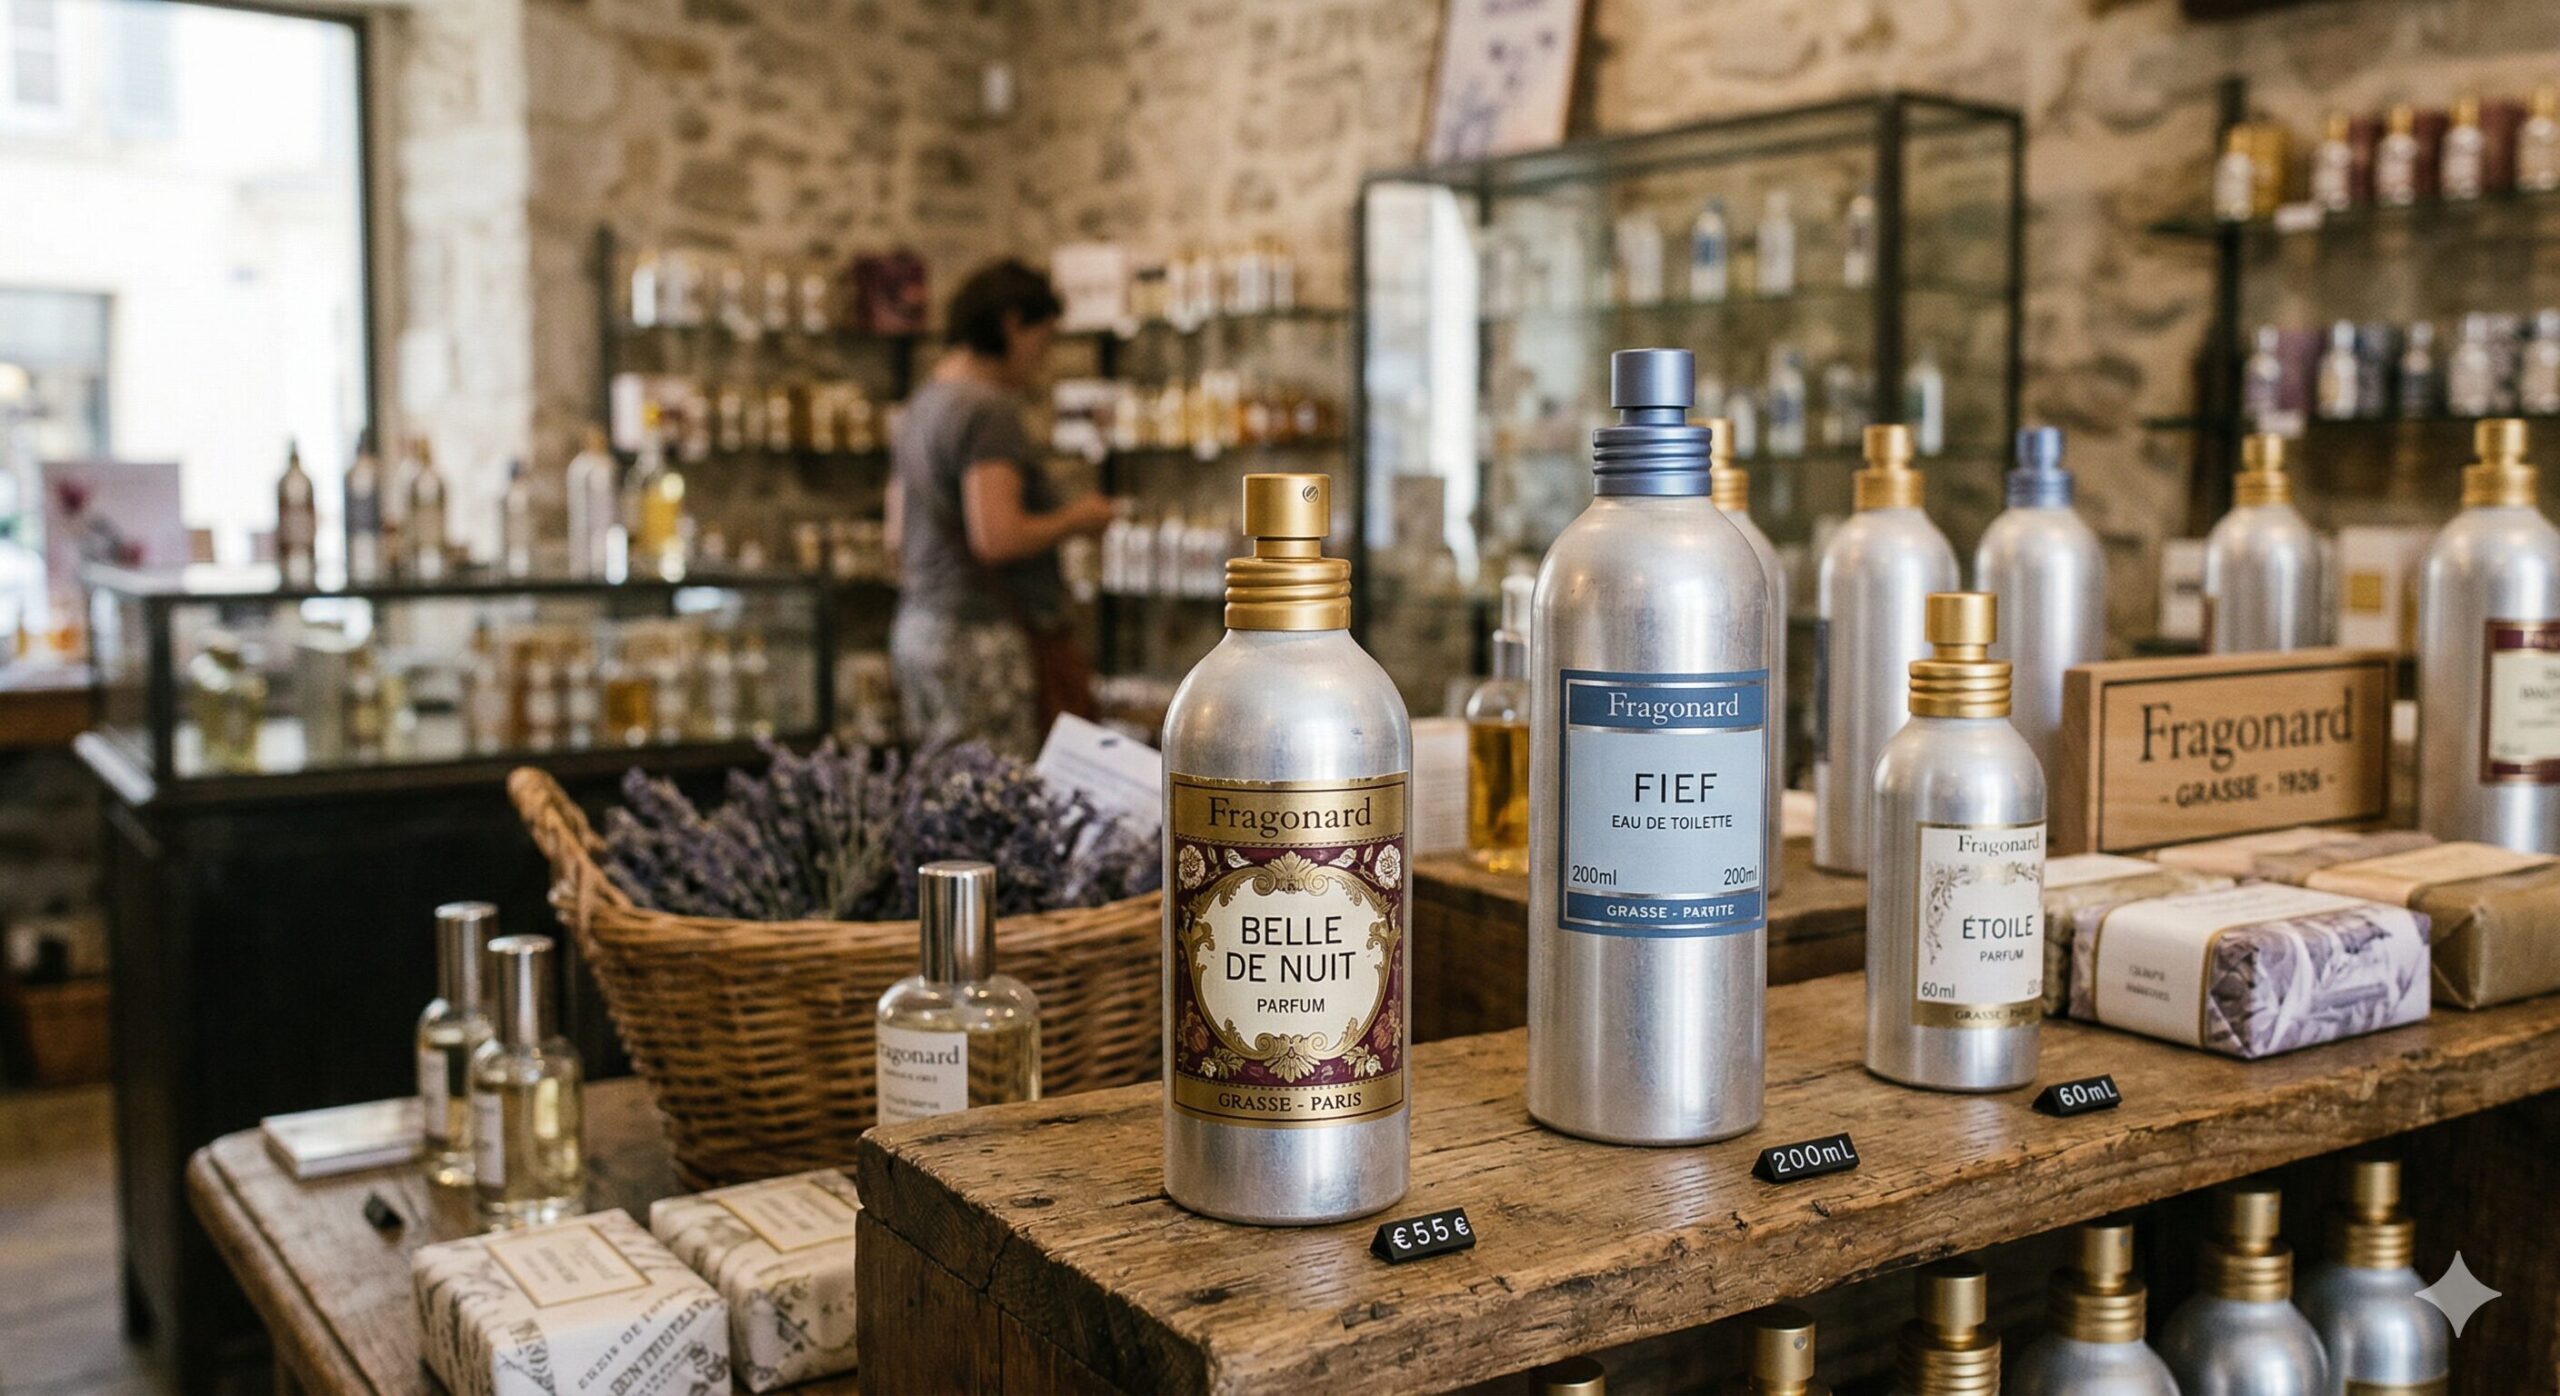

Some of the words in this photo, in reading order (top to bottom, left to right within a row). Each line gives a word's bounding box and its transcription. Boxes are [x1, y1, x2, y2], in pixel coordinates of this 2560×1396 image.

[1608, 691, 1739, 725] Fragonard
[2140, 686, 2353, 773] Fragonard
[1635, 773, 1718, 803] FIEF
[2175, 775, 2260, 808] GRASSE
[1208, 796, 1373, 838] Fragonard
[1612, 815, 1641, 829] EAU
[1647, 816, 1666, 830] DE
[1671, 814, 1733, 830] TOILETTE
[1958, 831, 2040, 857] Fragonard
[1572, 865, 1617, 885] 200ml
[1724, 865, 1757, 885] 200ml
[1607, 904, 1667, 918] GRASSE
[1242, 916, 1342, 946] BELLE
[1963, 915, 2034, 940] ÉTOILE
[1226, 951, 1267, 982] DE
[1280, 951, 1357, 983] NUIT
[1980, 949, 2024, 962] PARFUM
[1921, 981, 1956, 998] 60ml
[1257, 998, 1325, 1014] PARFUM
[1954, 1010, 2002, 1021] GRASSE
[1218, 1092, 1292, 1112] GRASSE
[1311, 1091, 1362, 1111] PARIS
[2060, 1080, 2118, 1107] 60mL
[1773, 1139, 1855, 1174] 200mL
